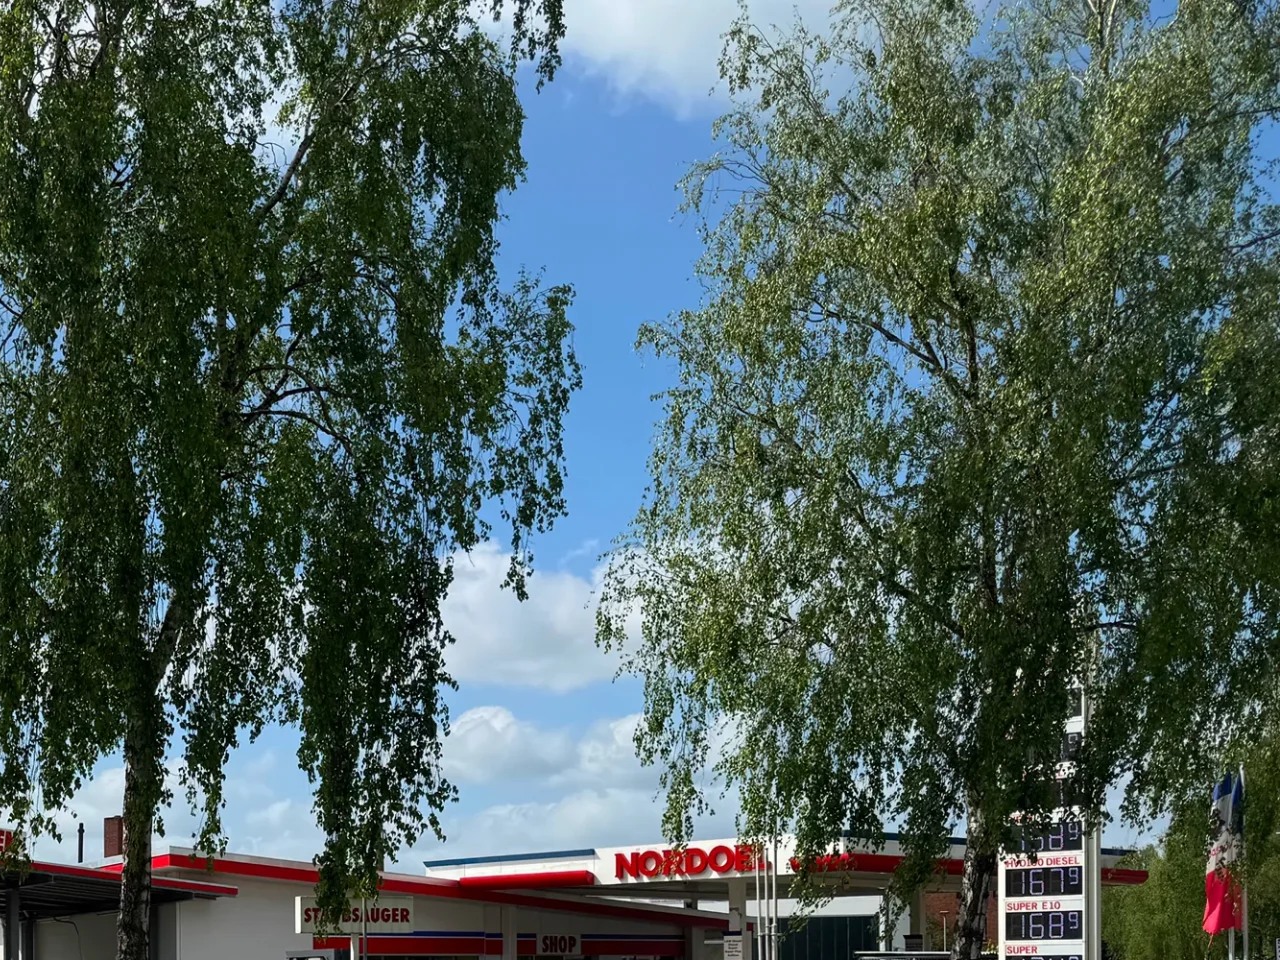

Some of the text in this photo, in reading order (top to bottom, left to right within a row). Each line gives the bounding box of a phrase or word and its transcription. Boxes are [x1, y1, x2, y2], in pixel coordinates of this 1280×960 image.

[1045, 856, 1080, 866] DIESEL
[1006, 901, 1038, 911] SUPER
[304, 907, 410, 923] STBSAUGER
[542, 935, 577, 953] SHOP
[1006, 946, 1038, 954] SUPER
